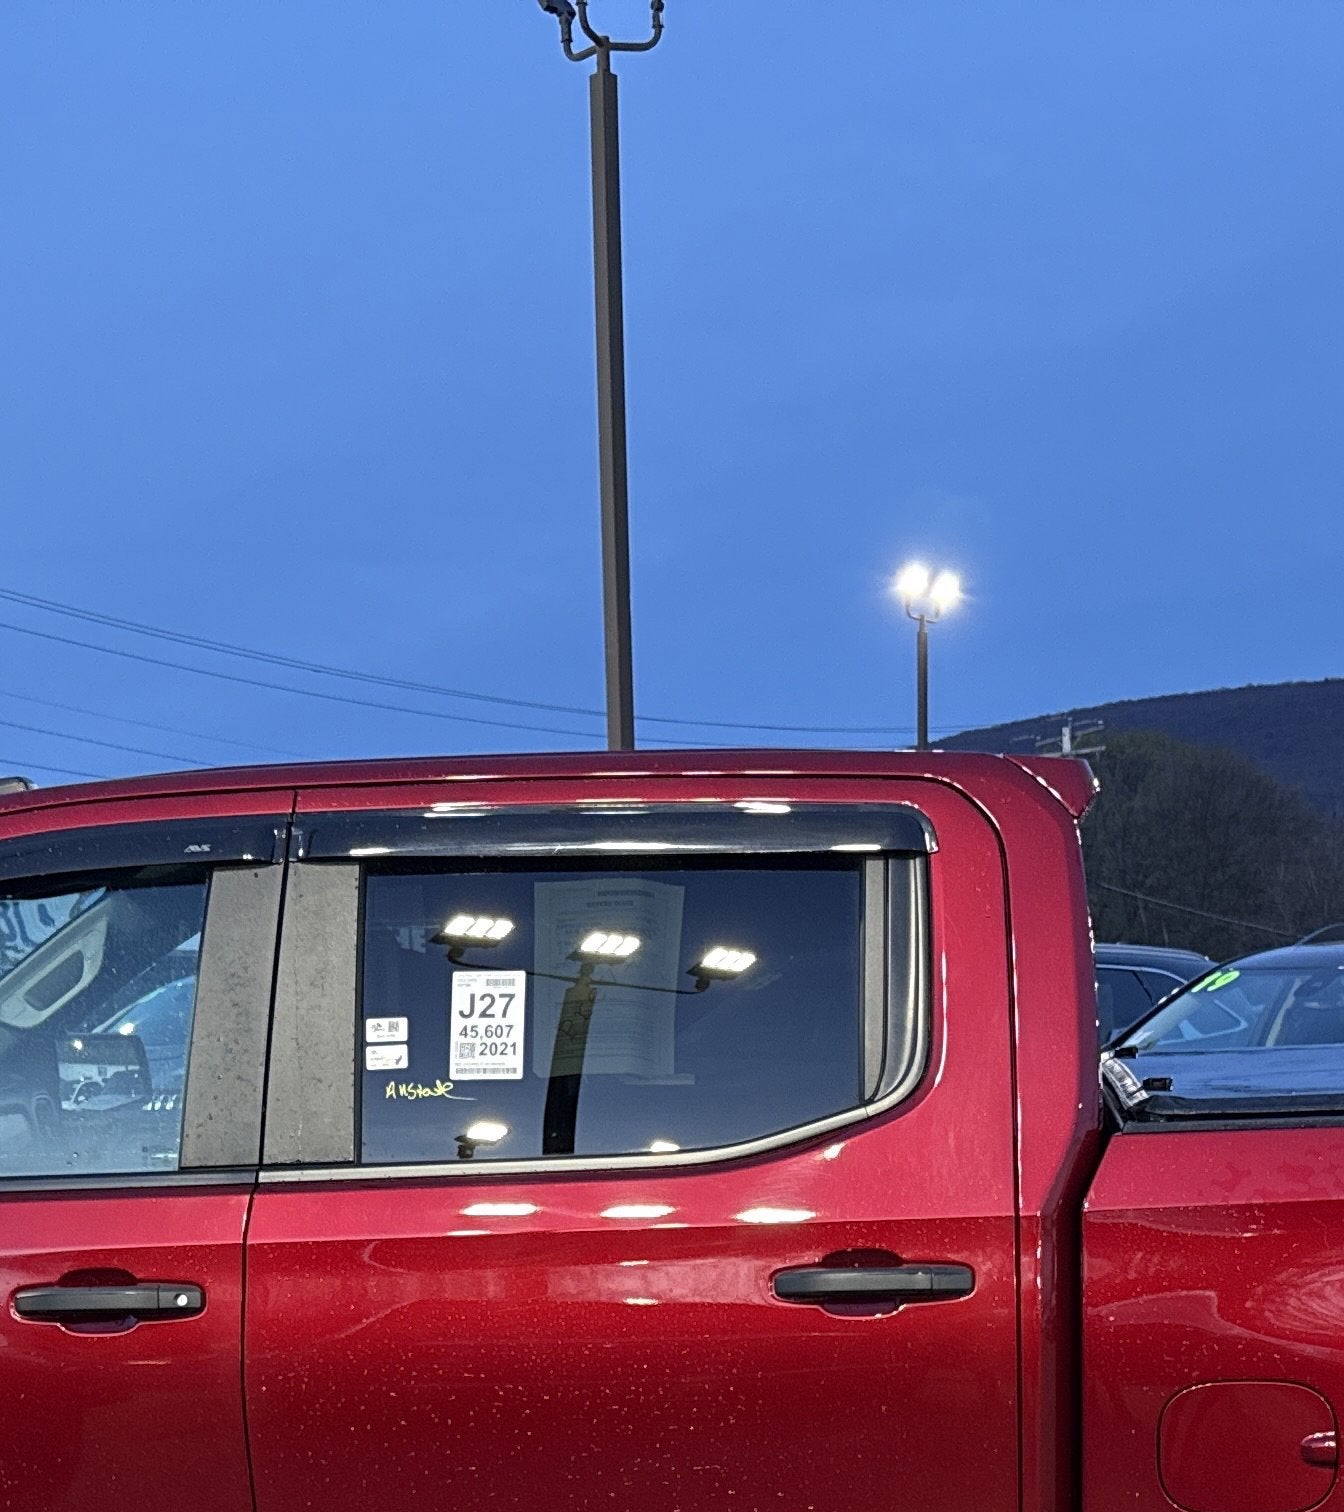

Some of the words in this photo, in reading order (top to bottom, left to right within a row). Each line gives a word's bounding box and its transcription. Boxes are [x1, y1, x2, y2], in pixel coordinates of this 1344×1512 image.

[458, 993, 516, 1019] J27
[459, 1024, 514, 1041] 45,607
[478, 1042, 517, 1056] 2021
